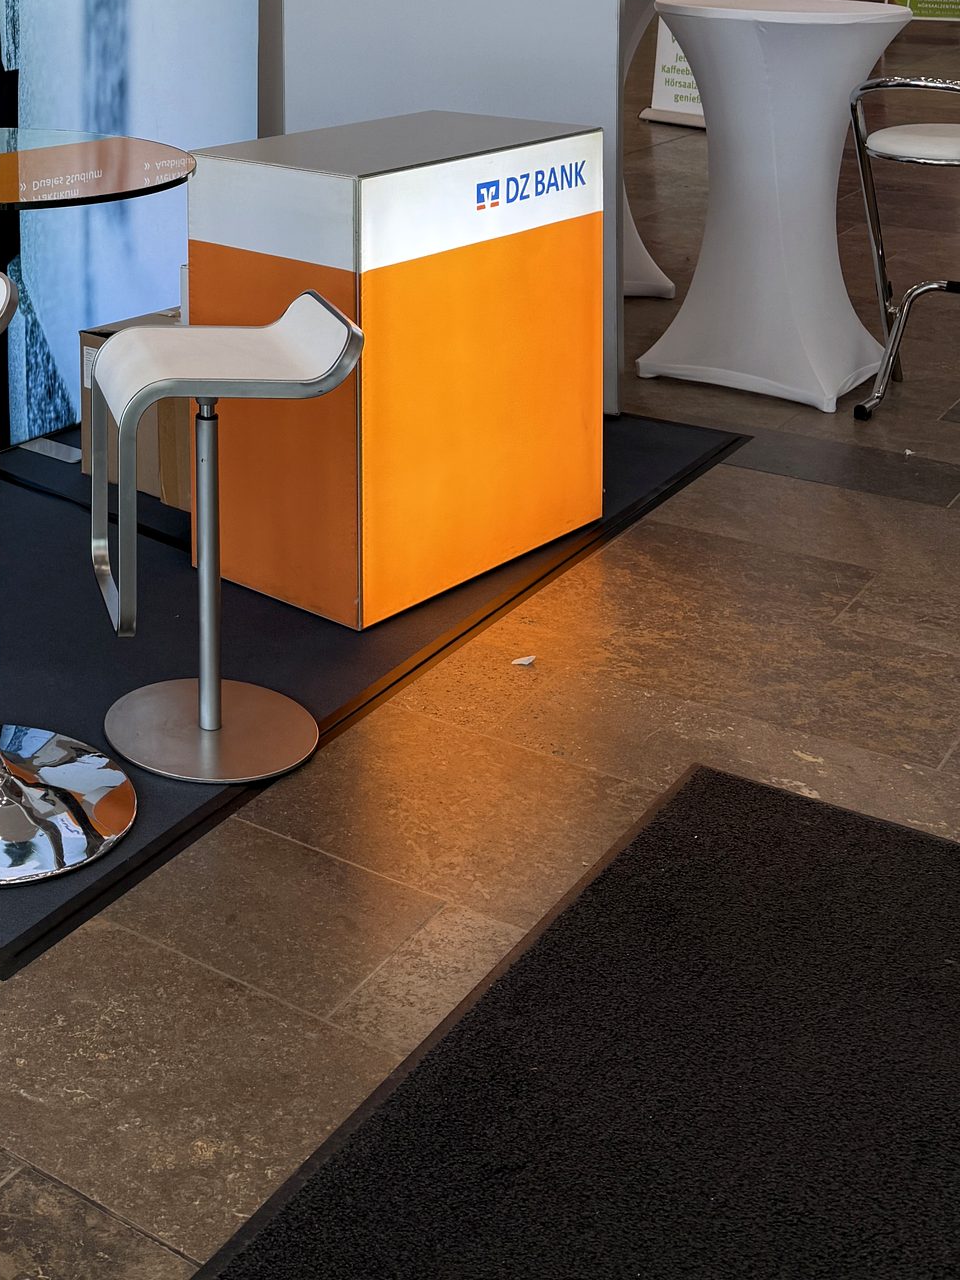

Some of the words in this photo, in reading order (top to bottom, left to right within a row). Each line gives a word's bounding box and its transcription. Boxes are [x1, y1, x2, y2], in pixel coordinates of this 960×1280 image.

[661, 64, 693, 76] Kaffeeb
[506, 173, 530, 203] DZ
[534, 160, 586, 197] BANK
